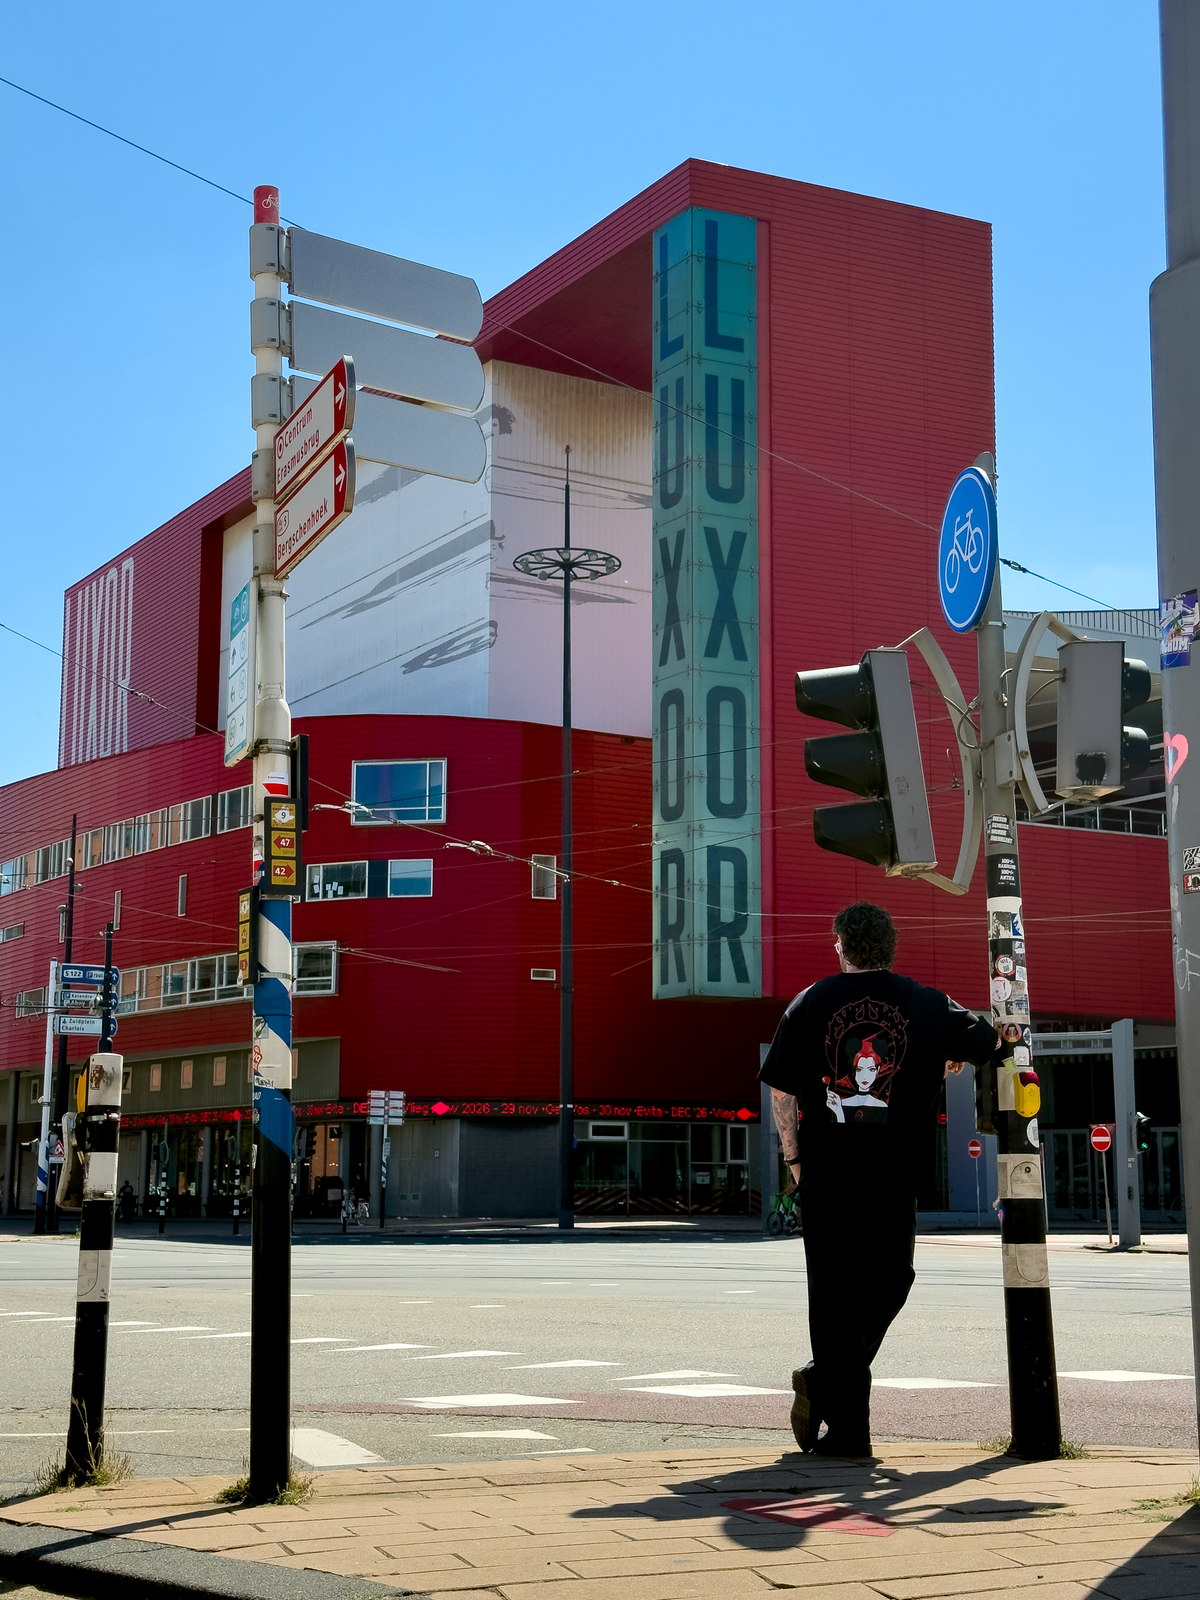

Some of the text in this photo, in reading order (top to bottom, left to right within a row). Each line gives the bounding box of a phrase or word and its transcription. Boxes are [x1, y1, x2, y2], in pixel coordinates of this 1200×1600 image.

[284, 408, 313, 448] Centrum
[277, 428, 320, 485] Erasmusbrug
[277, 498, 328, 561] Bergschenhoek
[281, 811, 286, 820] 9
[280, 838, 290, 847] 47
[275, 867, 286, 876] 42
[353, 1102, 368, 1114] DE
[461, 1102, 491, 1114] 2026
[501, 1102, 516, 1114] 29
[518, 1105, 538, 1114] nov
[598, 1105, 612, 1116] 30
[613, 1107, 632, 1116] nov
[671, 1107, 691, 1118] DEC
